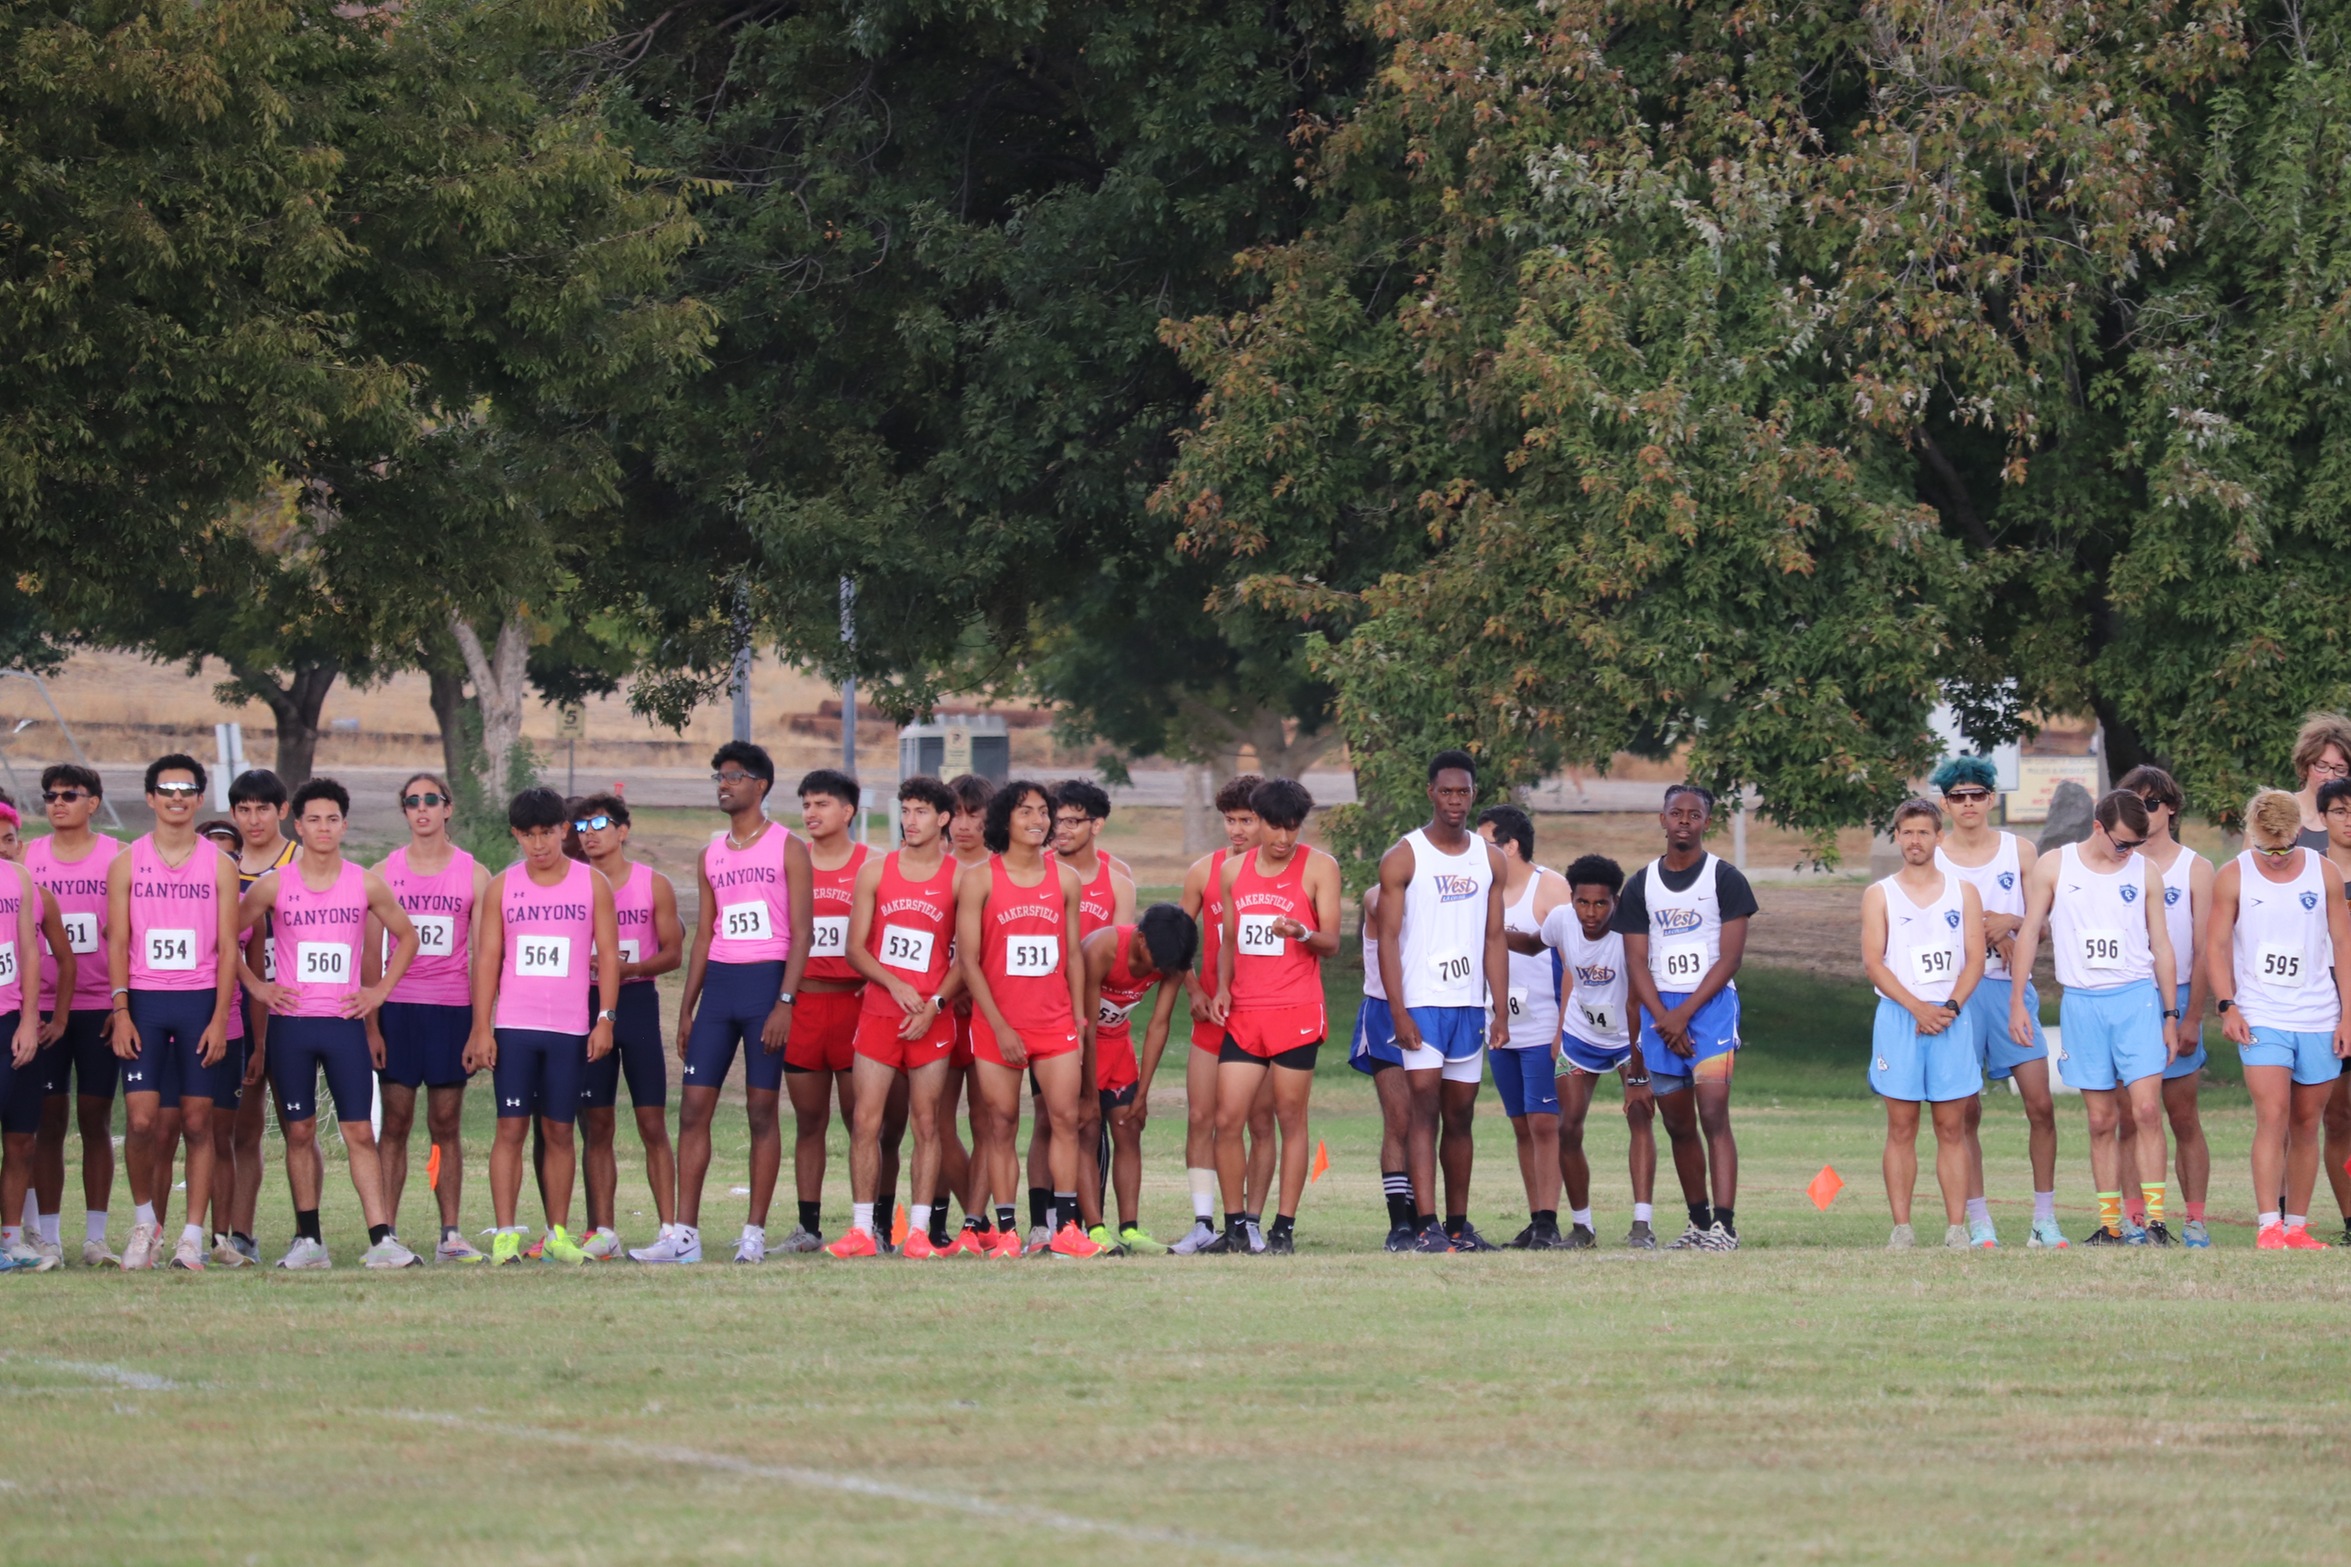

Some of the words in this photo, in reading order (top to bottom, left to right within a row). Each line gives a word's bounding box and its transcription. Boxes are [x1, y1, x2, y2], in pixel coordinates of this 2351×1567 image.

[564, 710, 577, 725] 5
[35, 880, 108, 896] NYONS
[710, 867, 776, 890] CANYONS
[1433, 874, 1473, 895] West
[134, 882, 210, 899] CANYONS
[398, 895, 463, 913] ANYONS
[880, 899, 945, 923] BAKERSFIELD
[1080, 901, 1109, 921] SFIELD
[1235, 893, 1295, 913] BAKERSFIELD
[283, 907, 360, 927] CANYONS
[506, 904, 587, 924] CANYONS
[729, 911, 760, 935] 553
[997, 905, 1060, 925] BAKERSFIELD
[1654, 908, 1697, 929] West
[65, 923, 87, 943] 61
[1245, 925, 1274, 945] 528
[153, 939, 187, 960] 554
[525, 946, 559, 967] 564
[889, 935, 922, 961] 532
[1017, 946, 1049, 967] 531
[2086, 939, 2118, 959] 596
[307, 952, 342, 973] 560
[1439, 956, 1471, 982] 700
[1668, 953, 1700, 975] 693
[1922, 951, 1952, 973] 597
[2264, 953, 2300, 977] 595
[1575, 963, 1610, 982] West
[1584, 1010, 1607, 1028] 94
